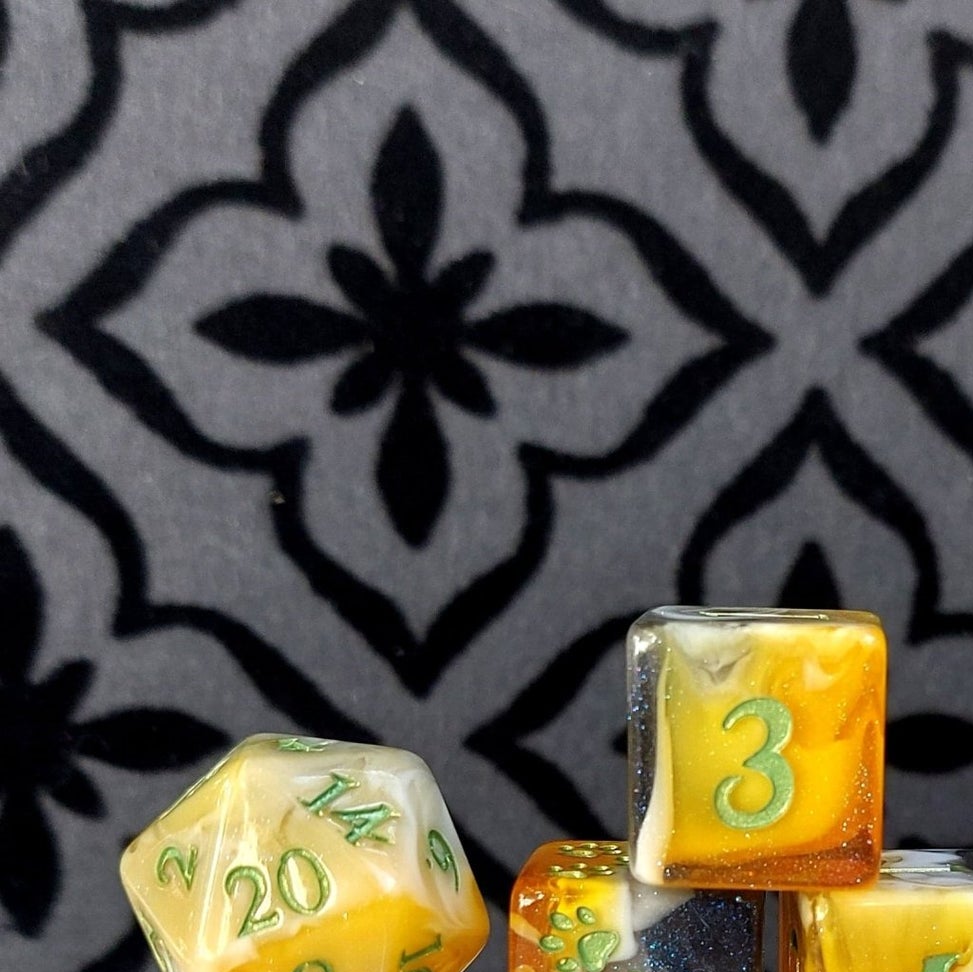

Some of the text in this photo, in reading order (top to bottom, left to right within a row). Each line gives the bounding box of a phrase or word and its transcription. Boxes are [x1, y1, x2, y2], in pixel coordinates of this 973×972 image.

[714, 696, 795, 831] 3
[299, 771, 401, 847] 14
[155, 842, 199, 892] 2
[223, 847, 334, 938] 20
